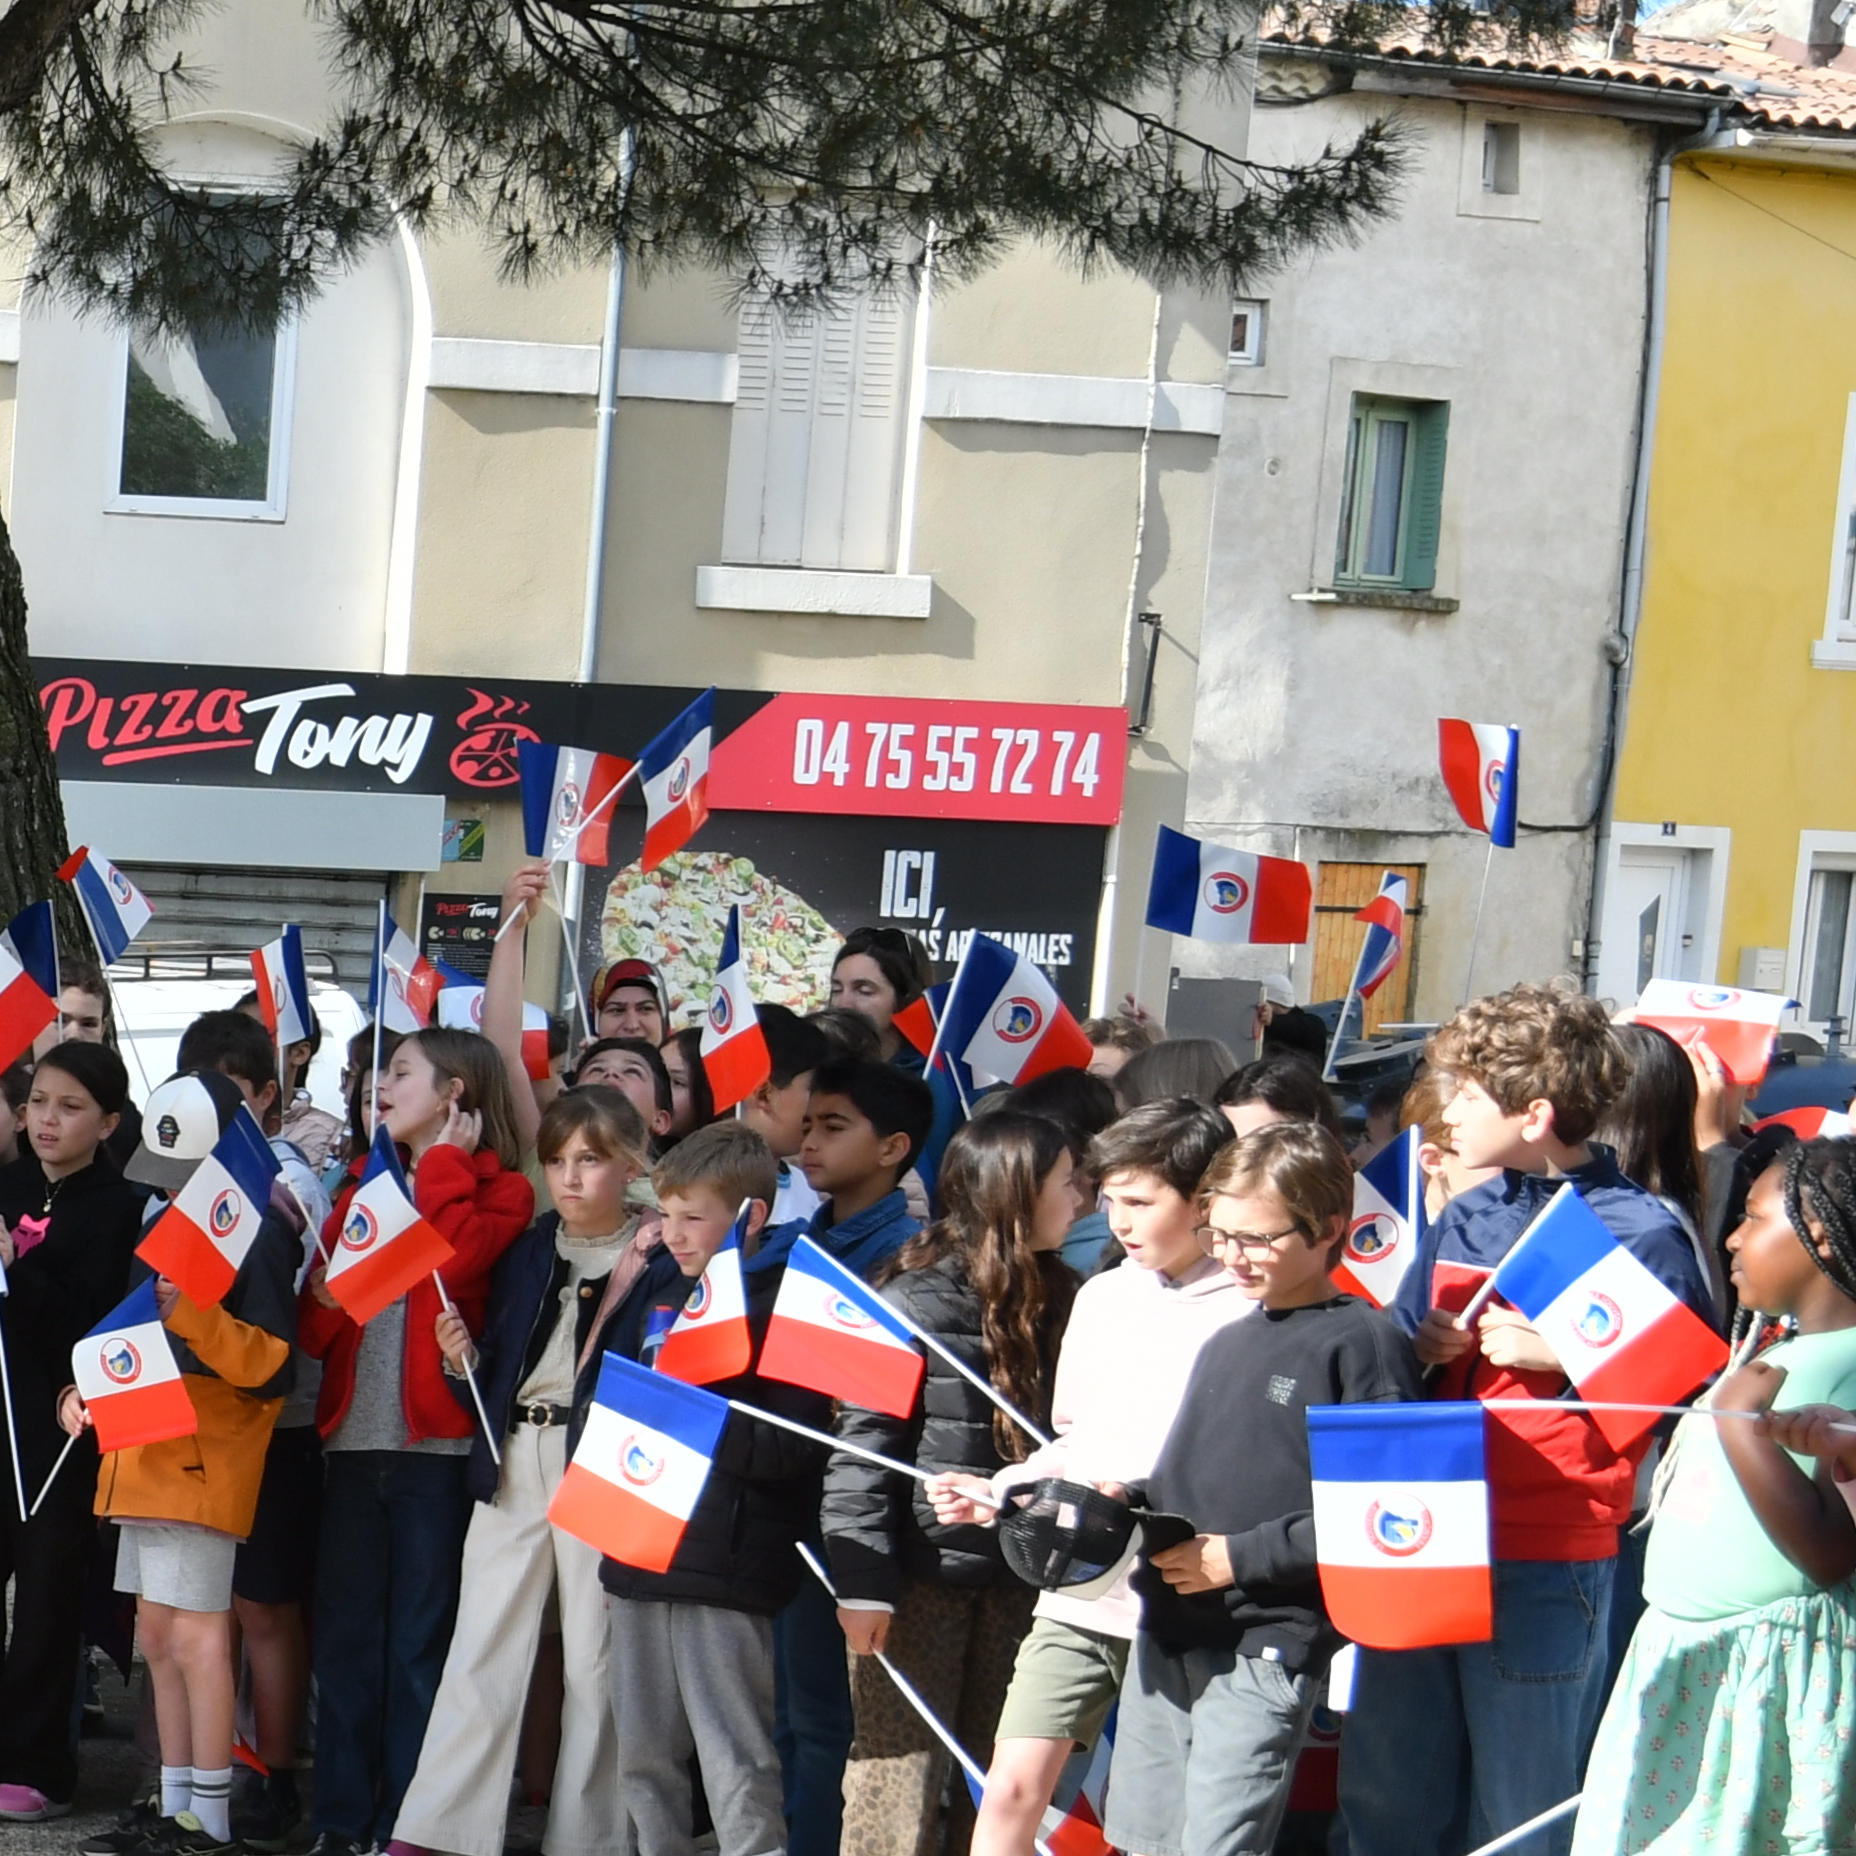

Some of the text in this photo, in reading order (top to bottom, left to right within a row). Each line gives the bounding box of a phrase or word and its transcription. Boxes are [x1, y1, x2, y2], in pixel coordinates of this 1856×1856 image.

[39, 676, 434, 785] Pizza Tony
[792, 717, 1102, 798] 04 75 55 72 74
[879, 849, 947, 929] ICI,
[944, 929, 1074, 966] ARANALES
